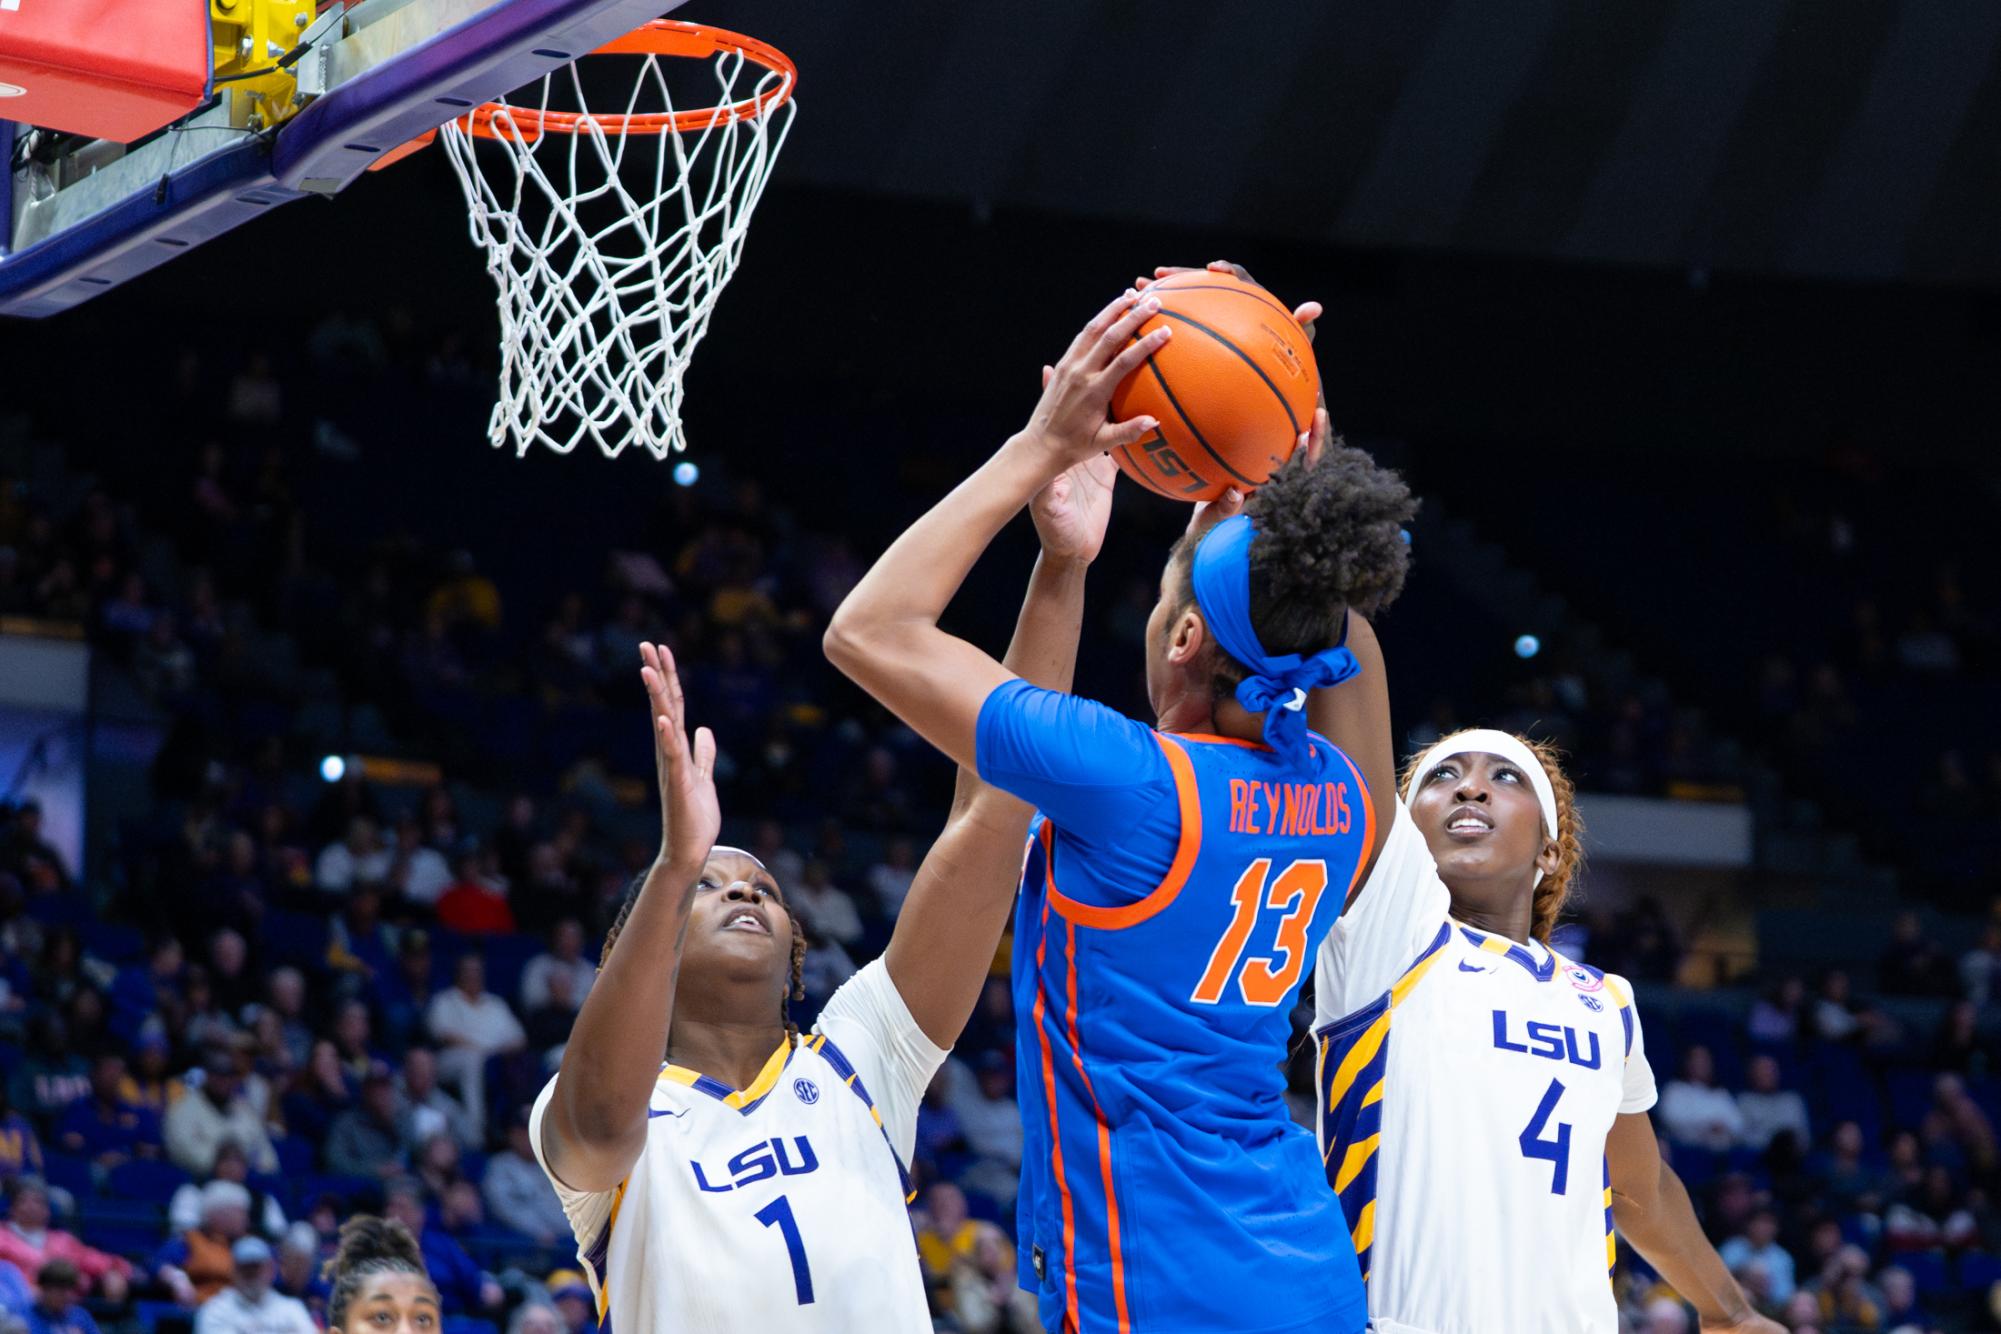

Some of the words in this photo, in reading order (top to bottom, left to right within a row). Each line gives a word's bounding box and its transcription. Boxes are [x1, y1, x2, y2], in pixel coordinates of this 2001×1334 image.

[1229, 778, 1352, 837] REYNOLDS
[1190, 857, 1328, 1006] 13
[1492, 1009, 1601, 1071] LSU
[795, 1080, 817, 1102] SEC
[689, 1135, 819, 1193] LSU
[1518, 1077, 1572, 1195] 4
[753, 1194, 815, 1306] 1
